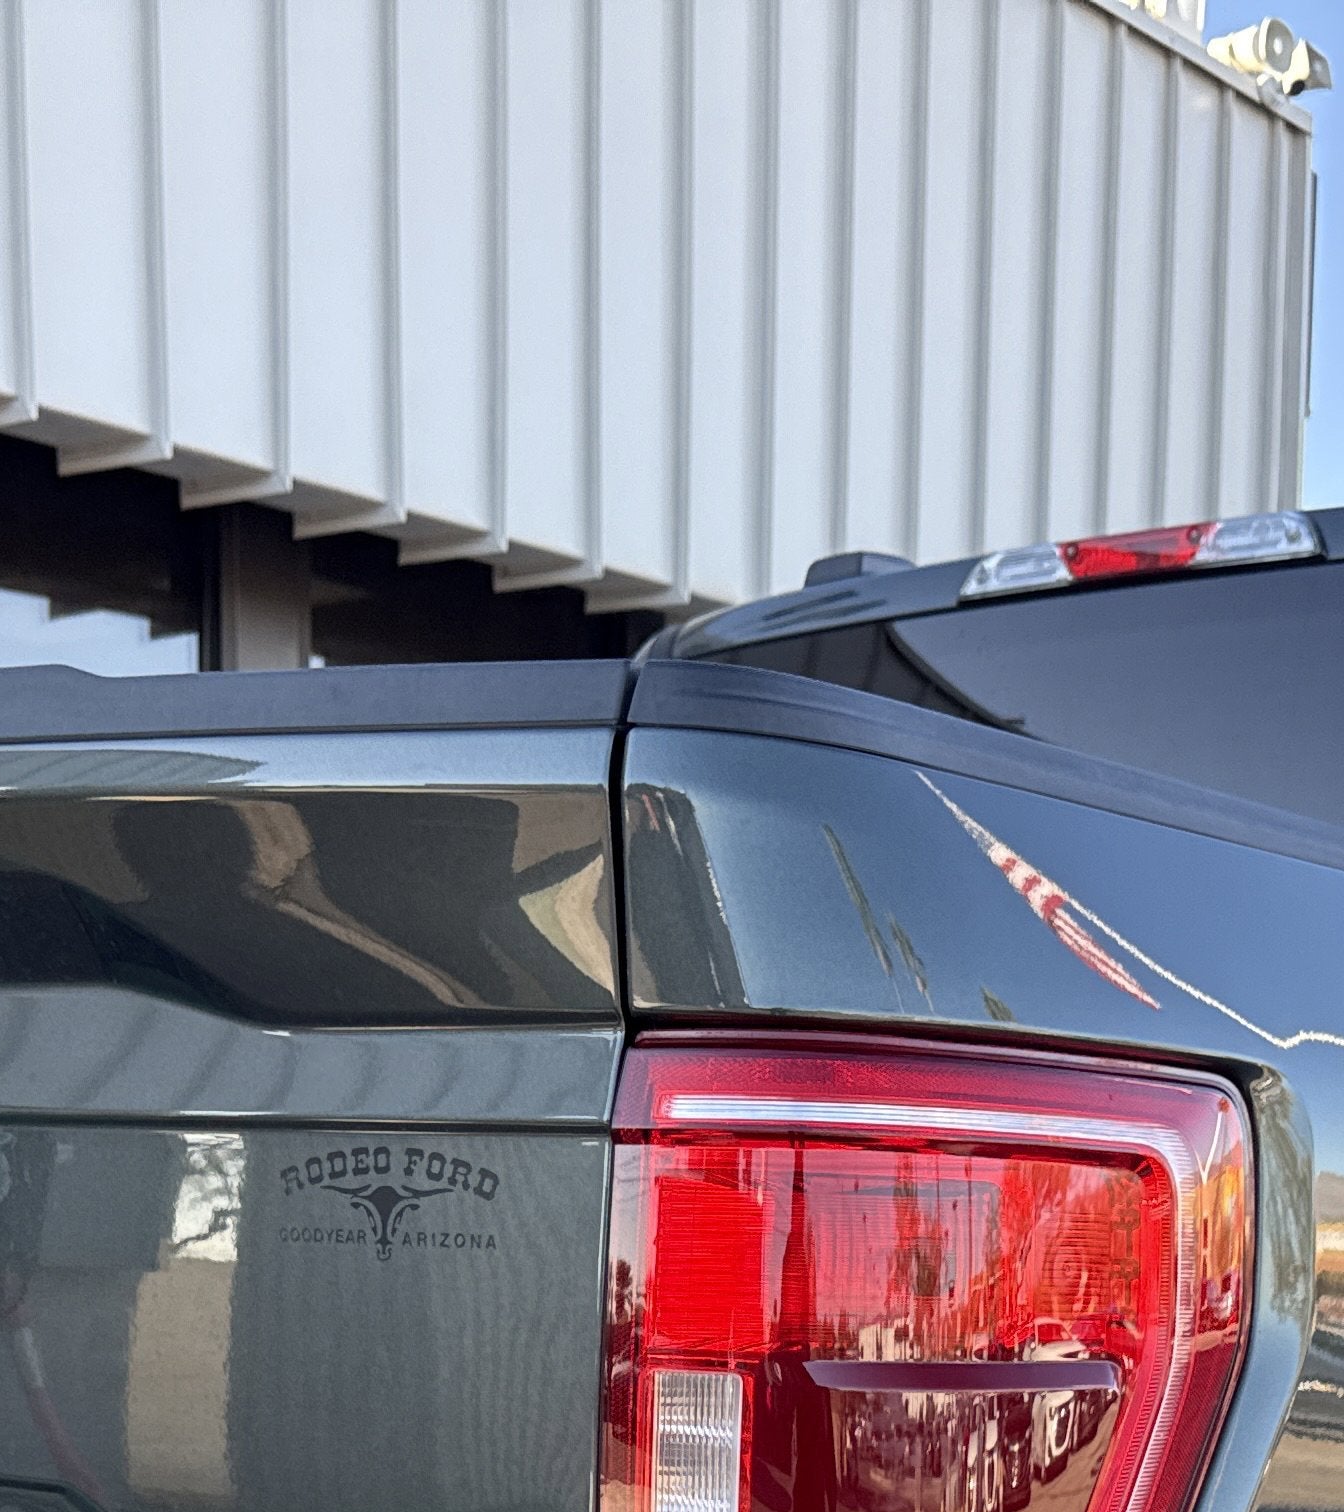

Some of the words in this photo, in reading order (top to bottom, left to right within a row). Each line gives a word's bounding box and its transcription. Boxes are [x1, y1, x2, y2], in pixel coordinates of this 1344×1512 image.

[279, 1146, 391, 1196] RODEO
[403, 1147, 500, 1201] FORD
[278, 1226, 368, 1245] GOODYEAR
[402, 1231, 497, 1250] ARIZONA
